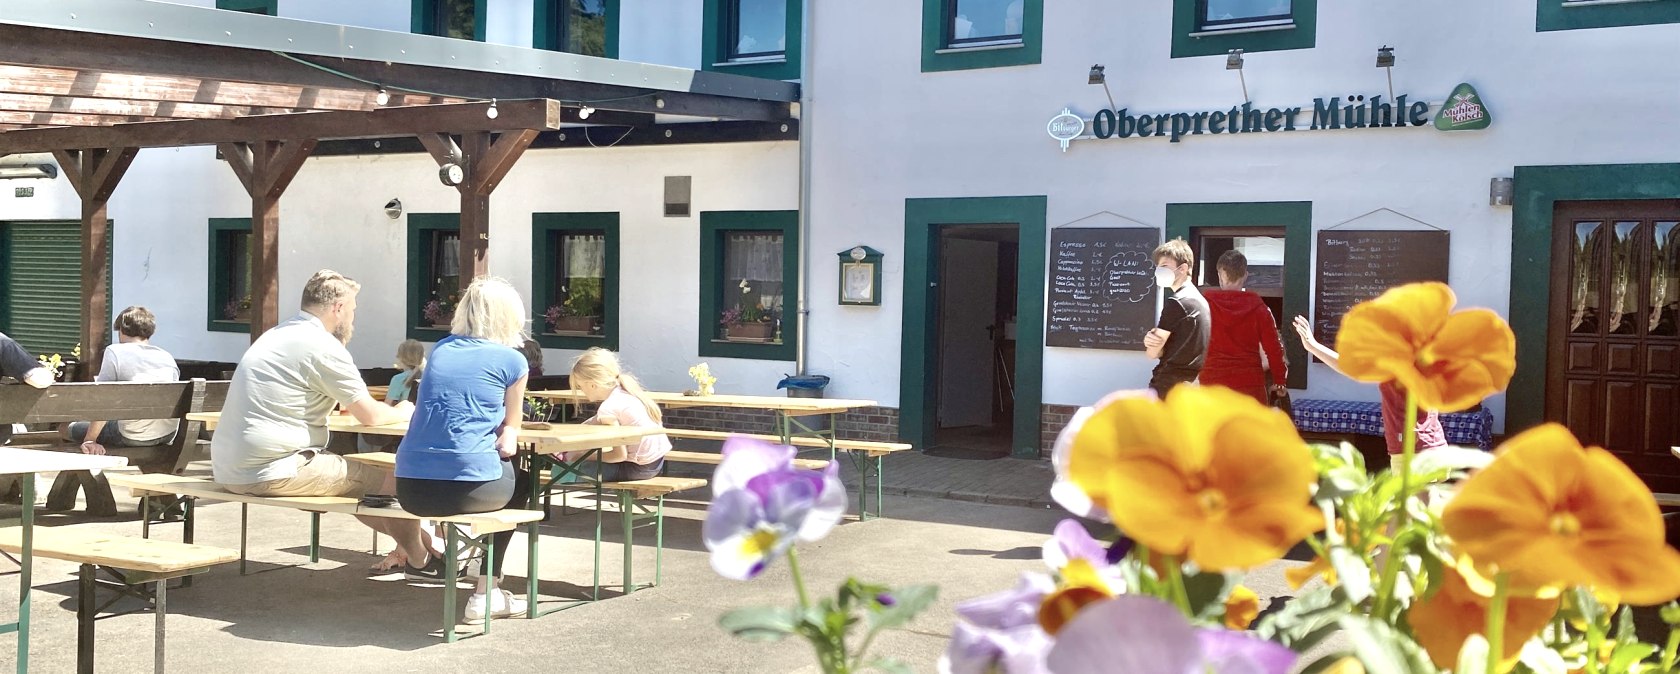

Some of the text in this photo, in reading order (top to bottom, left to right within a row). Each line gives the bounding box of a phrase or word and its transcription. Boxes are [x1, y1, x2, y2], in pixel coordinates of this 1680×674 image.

[1093, 94, 1429, 143] Oberprether Mühle
[1060, 241, 1087, 249] Espresso
[1059, 250, 1076, 258] Kaffee
